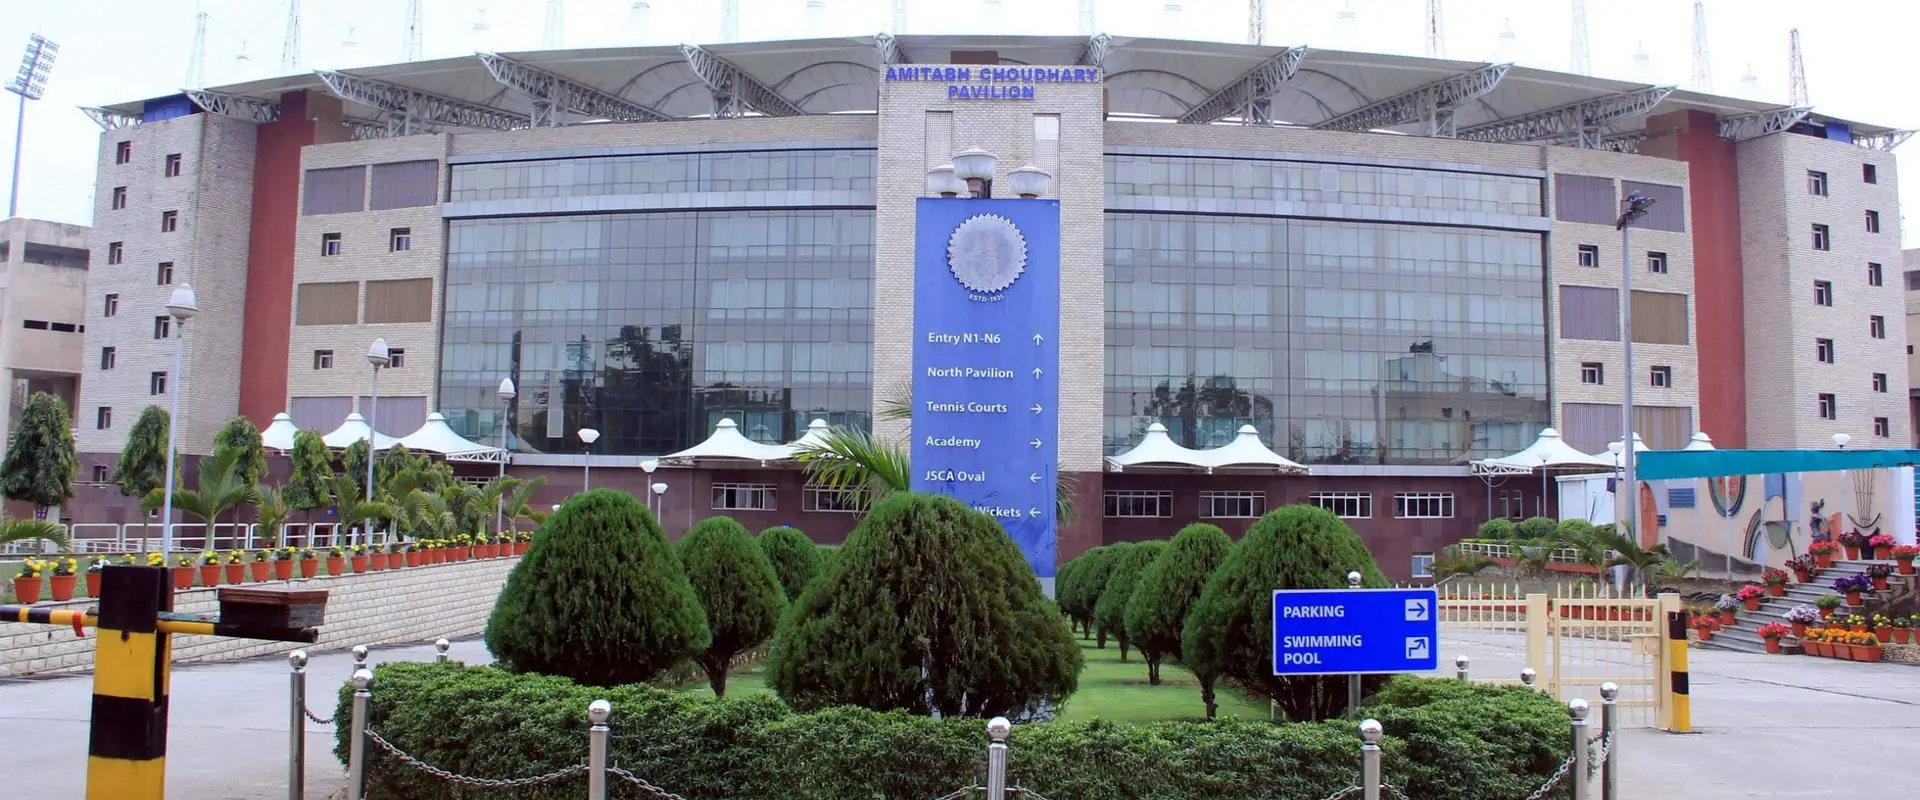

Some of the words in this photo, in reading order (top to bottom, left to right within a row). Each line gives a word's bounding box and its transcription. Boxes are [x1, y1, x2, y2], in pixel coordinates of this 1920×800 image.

[885, 67, 970, 81] AMITABH
[980, 67, 1098, 82] CHOUDHARY
[948, 85, 1035, 99] PAVILION
[928, 332, 960, 345] Entry
[963, 333, 1001, 344] N1-N6
[927, 367, 962, 377] North
[966, 367, 1014, 379] Pavilion
[926, 401, 965, 412] Tennis
[967, 402, 1008, 413] Courts
[925, 436, 981, 449] Academy
[924, 470, 954, 482] JSCA
[957, 471, 985, 482] Oval
[1283, 605, 1345, 618] PARKING
[1283, 634, 1363, 648] SWIMMING
[1283, 652, 1322, 665] POOL
